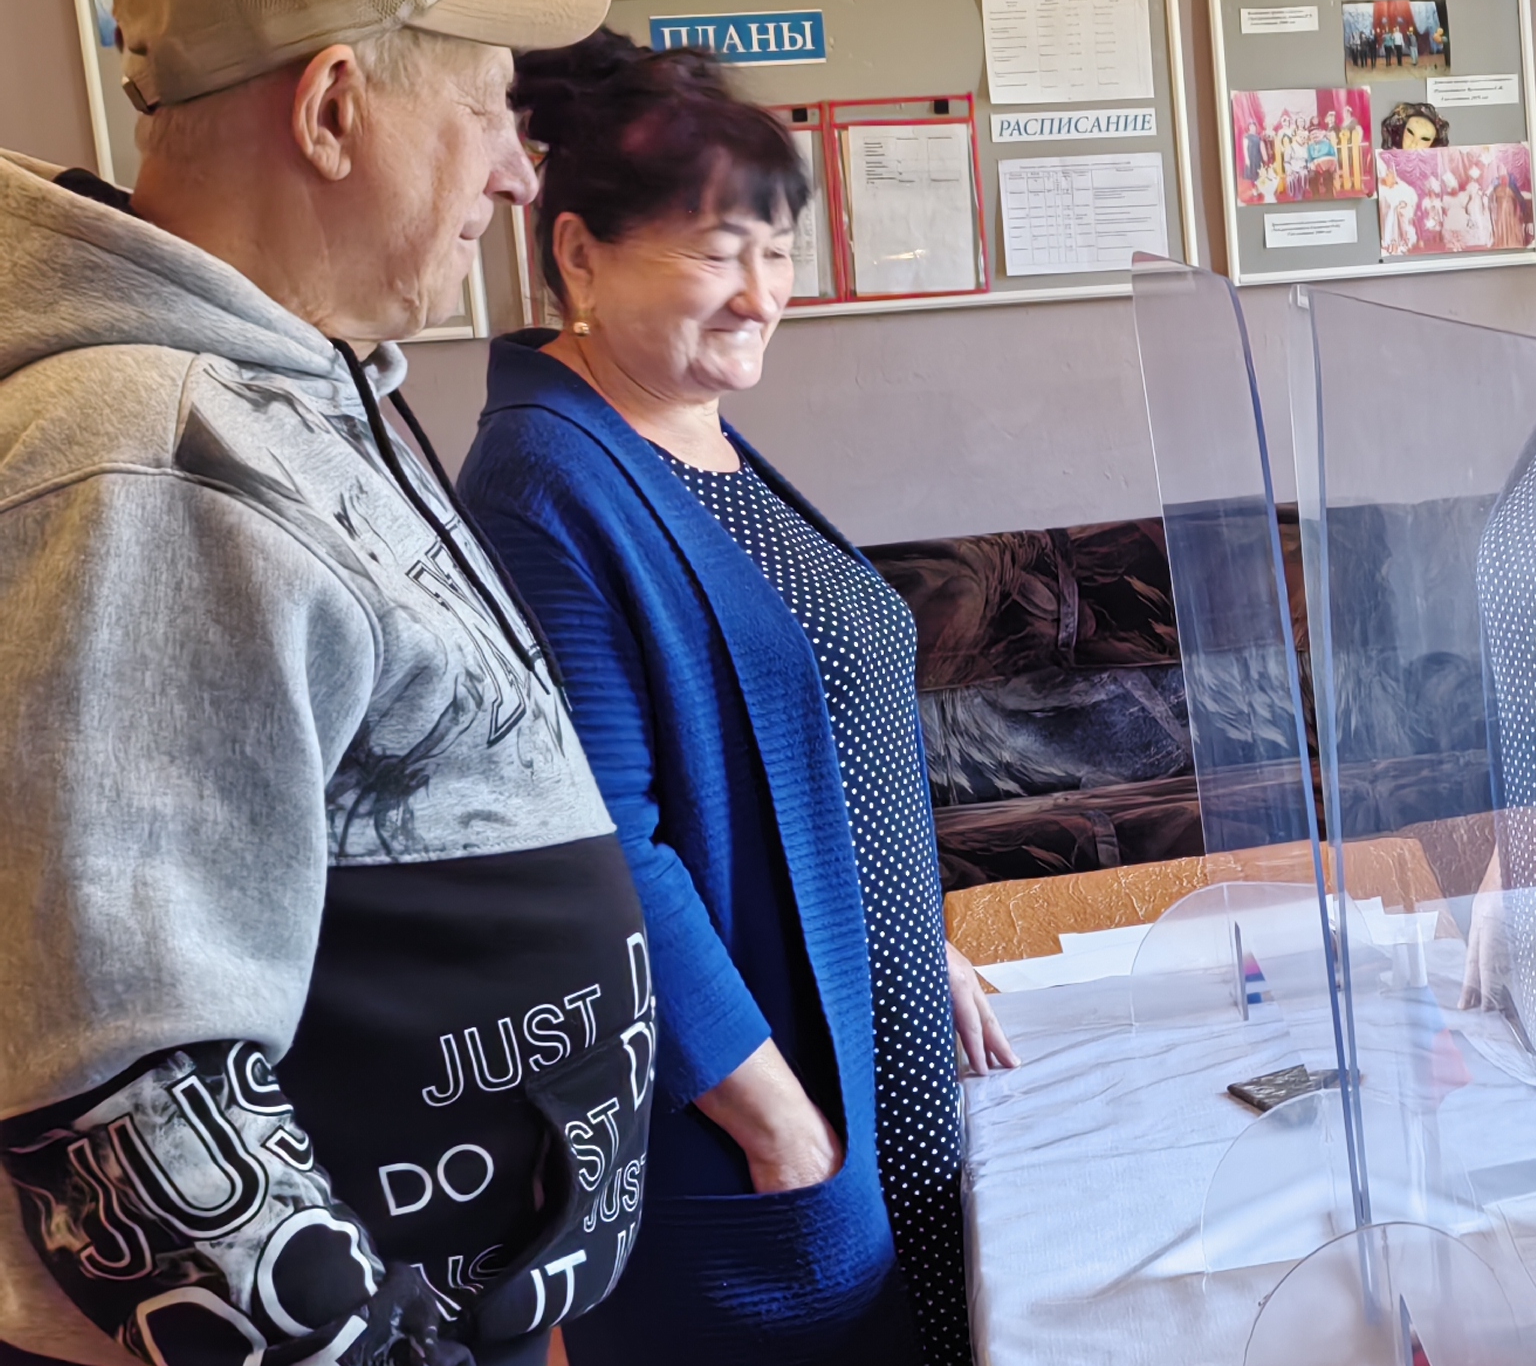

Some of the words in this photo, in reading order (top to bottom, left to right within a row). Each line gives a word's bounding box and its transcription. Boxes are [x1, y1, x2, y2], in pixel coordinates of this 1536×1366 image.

[660, 21, 816, 54] ПЛАНЫ
[999, 113, 1153, 137] РАСПИСАНИЕ
[422, 984, 601, 1107] JUST
[67, 1040, 314, 1280] JUS
[378, 1144, 494, 1216] DO
